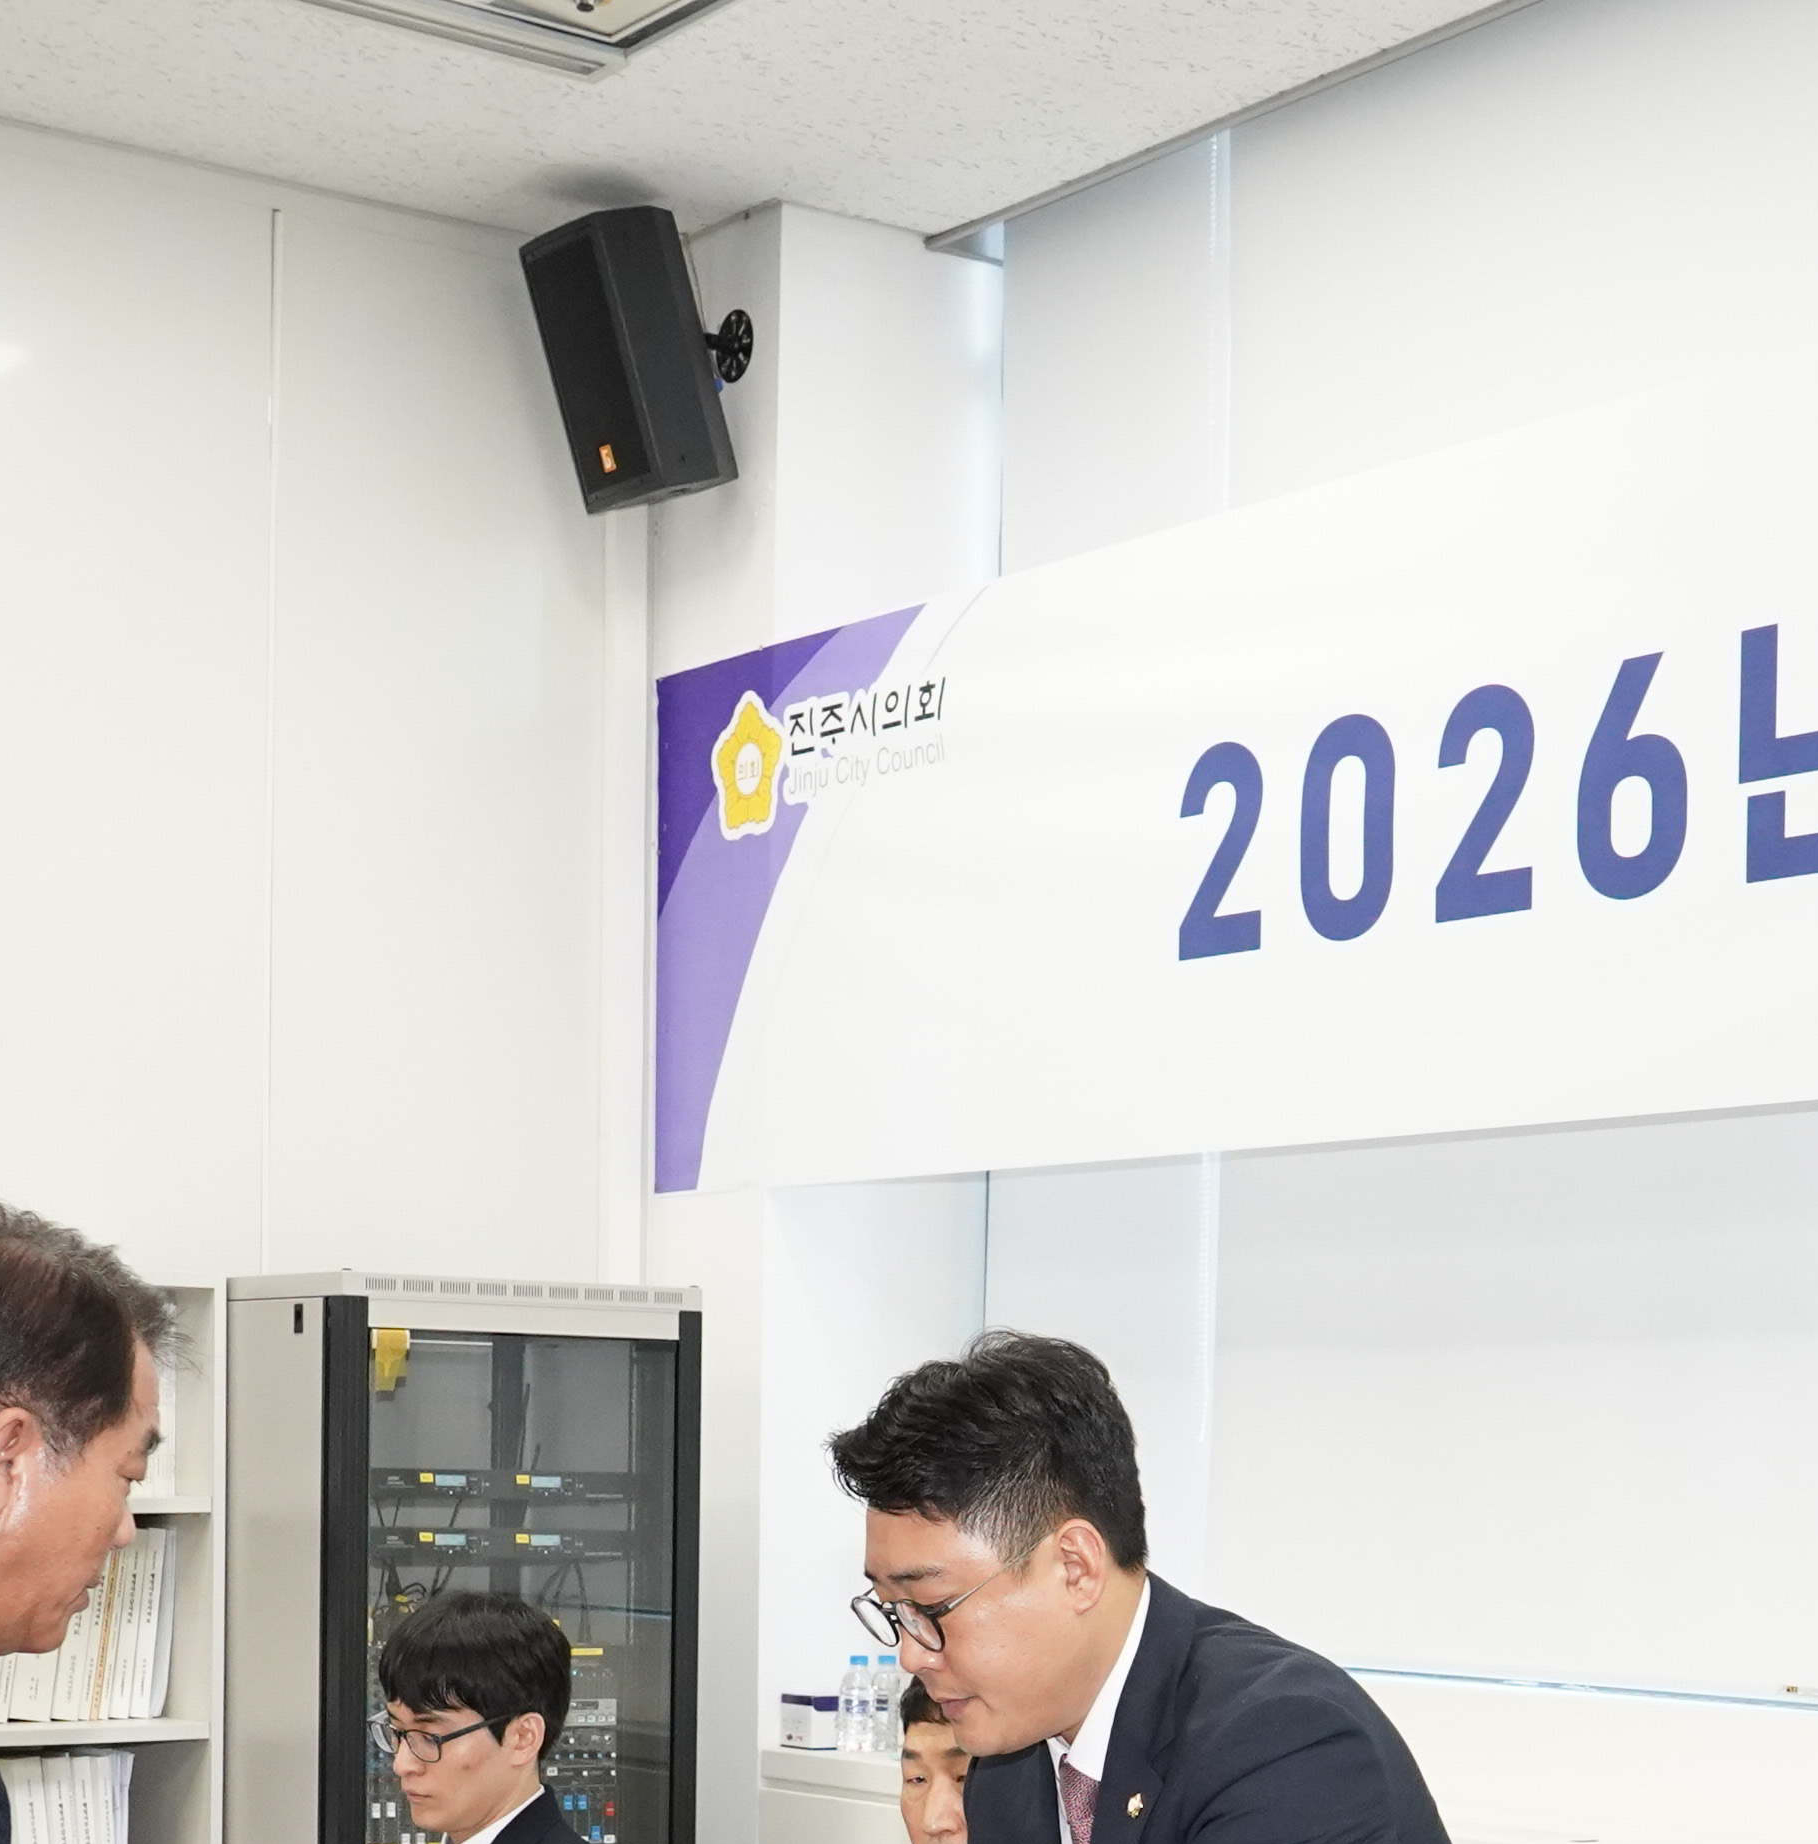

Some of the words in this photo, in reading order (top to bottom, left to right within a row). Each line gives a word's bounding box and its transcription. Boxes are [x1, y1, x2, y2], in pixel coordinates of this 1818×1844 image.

[788, 676, 946, 757] 진주시의회
[788, 765, 829, 798] Jinju
[835, 754, 871, 788] City
[876, 734, 946, 776] Council
